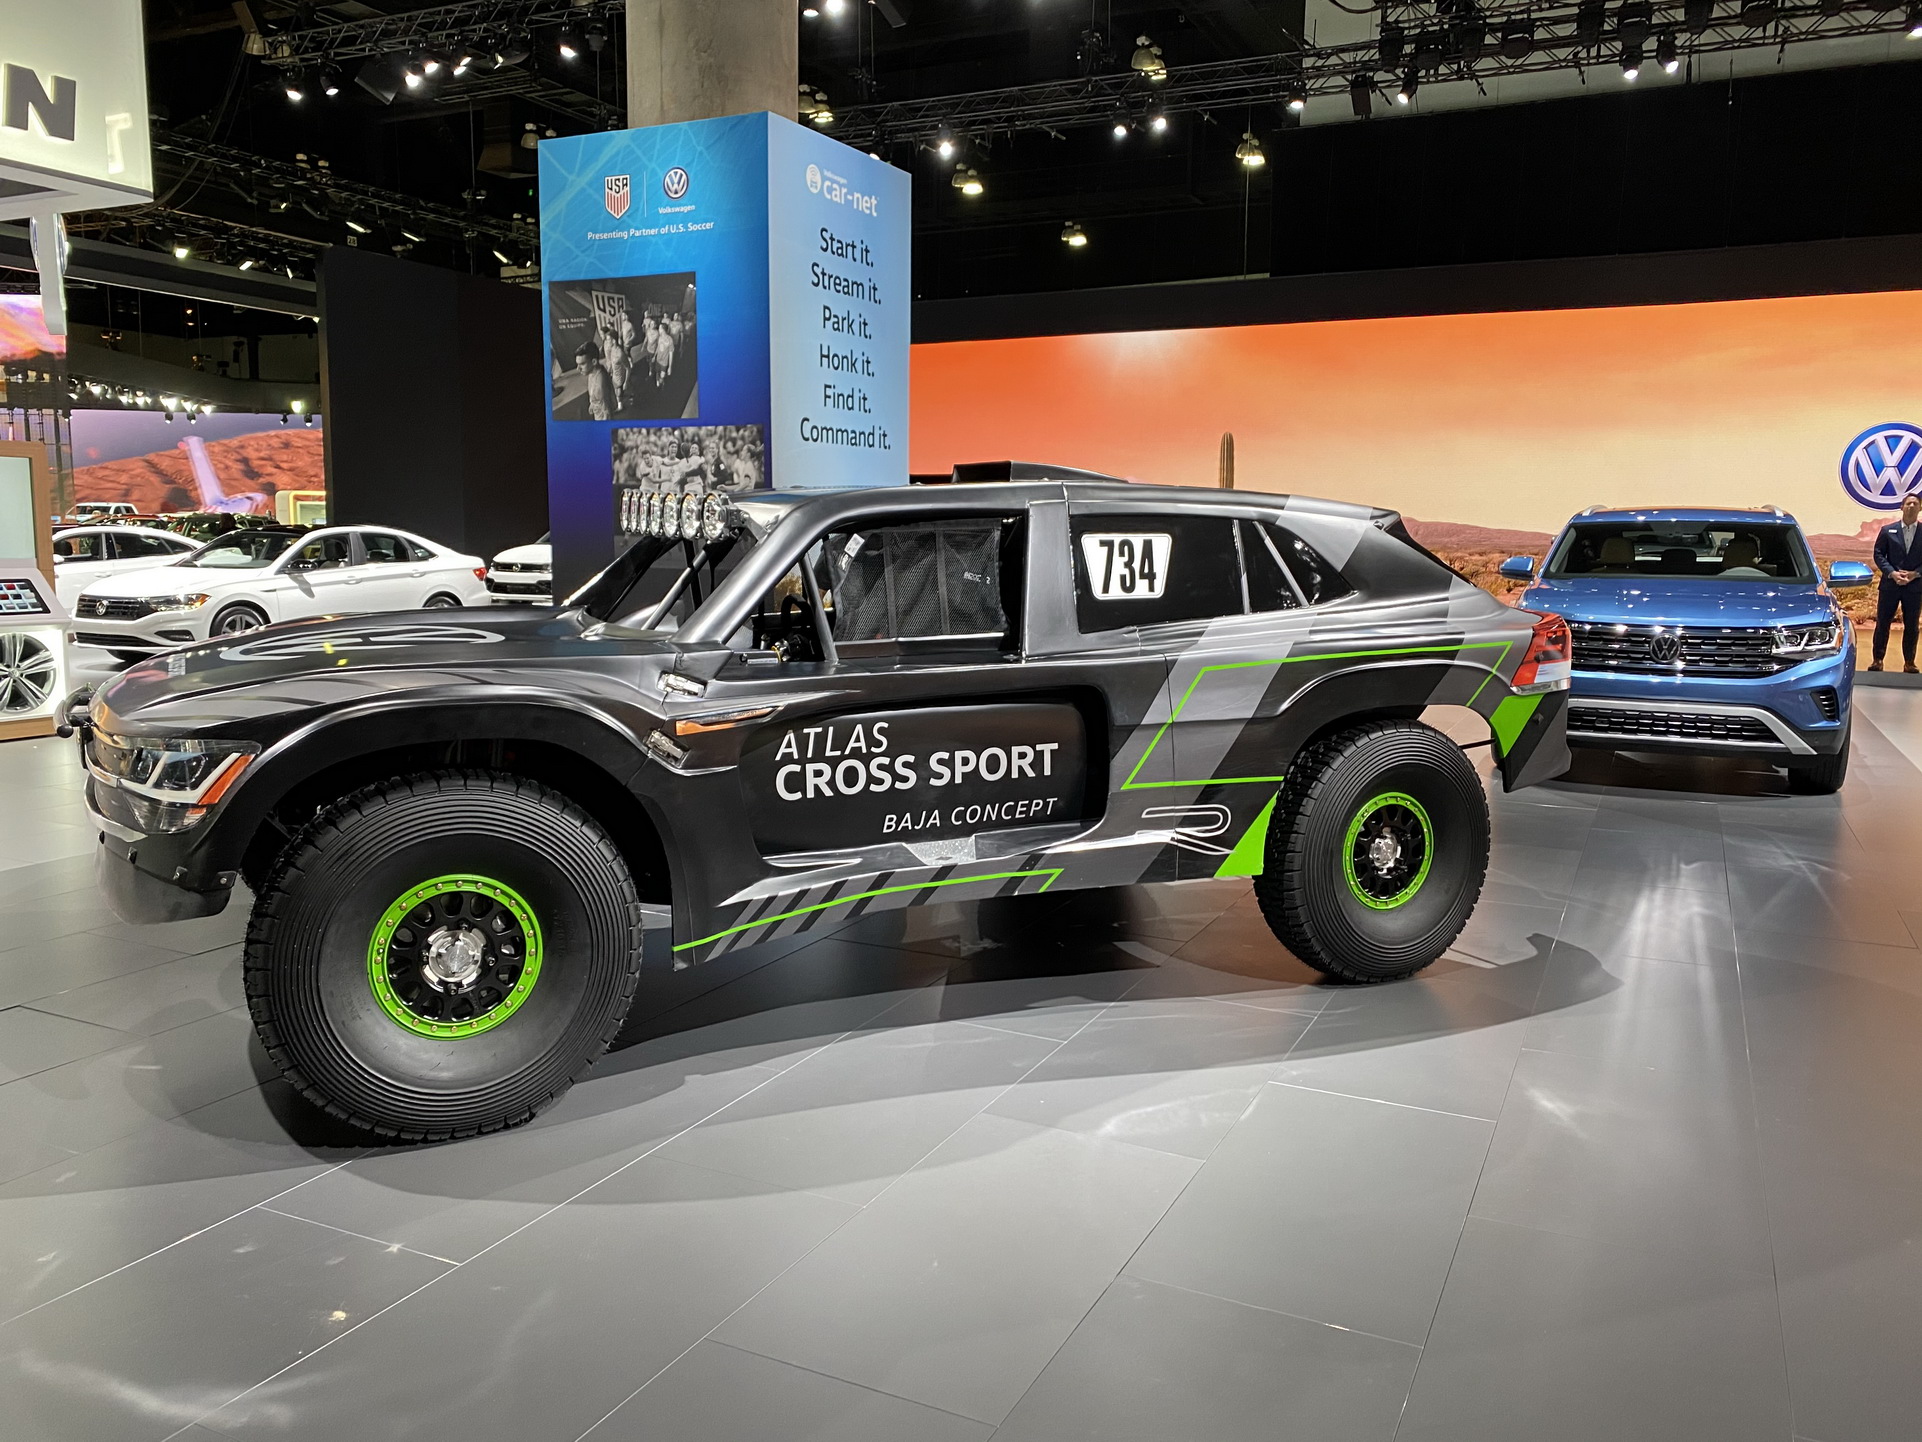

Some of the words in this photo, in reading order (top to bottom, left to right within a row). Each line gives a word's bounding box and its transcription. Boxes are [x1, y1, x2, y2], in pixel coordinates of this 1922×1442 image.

[606, 177, 629, 194] USA
[823, 180, 878, 217] car-net
[658, 205, 696, 214] Volkswagen
[587, 229, 628, 240] Presenting
[630, 228, 659, 237] Partner
[660, 224, 669, 234] of
[670, 223, 686, 233] U.S.
[687, 222, 714, 232] Soccer
[820, 227, 857, 262] Start
[860, 239, 874, 268] it.
[811, 262, 865, 300] Stream
[868, 277, 882, 305] it.
[596, 294, 625, 317] USA
[823, 304, 855, 335] Park
[859, 313, 872, 340] it.
[820, 343, 858, 374] Honk
[861, 351, 875, 377] it.
[824, 383, 854, 411] Find
[858, 388, 871, 414] it.
[800, 417, 875, 448] Command
[879, 426, 891, 450] it.
[1099, 538, 1157, 594] 734
[774, 721, 889, 761] ATLAS
[775, 754, 918, 801] CROSS
[928, 742, 1059, 787] SPORT
[882, 809, 941, 833] BAJA
[950, 797, 1058, 826] CONCEPT
